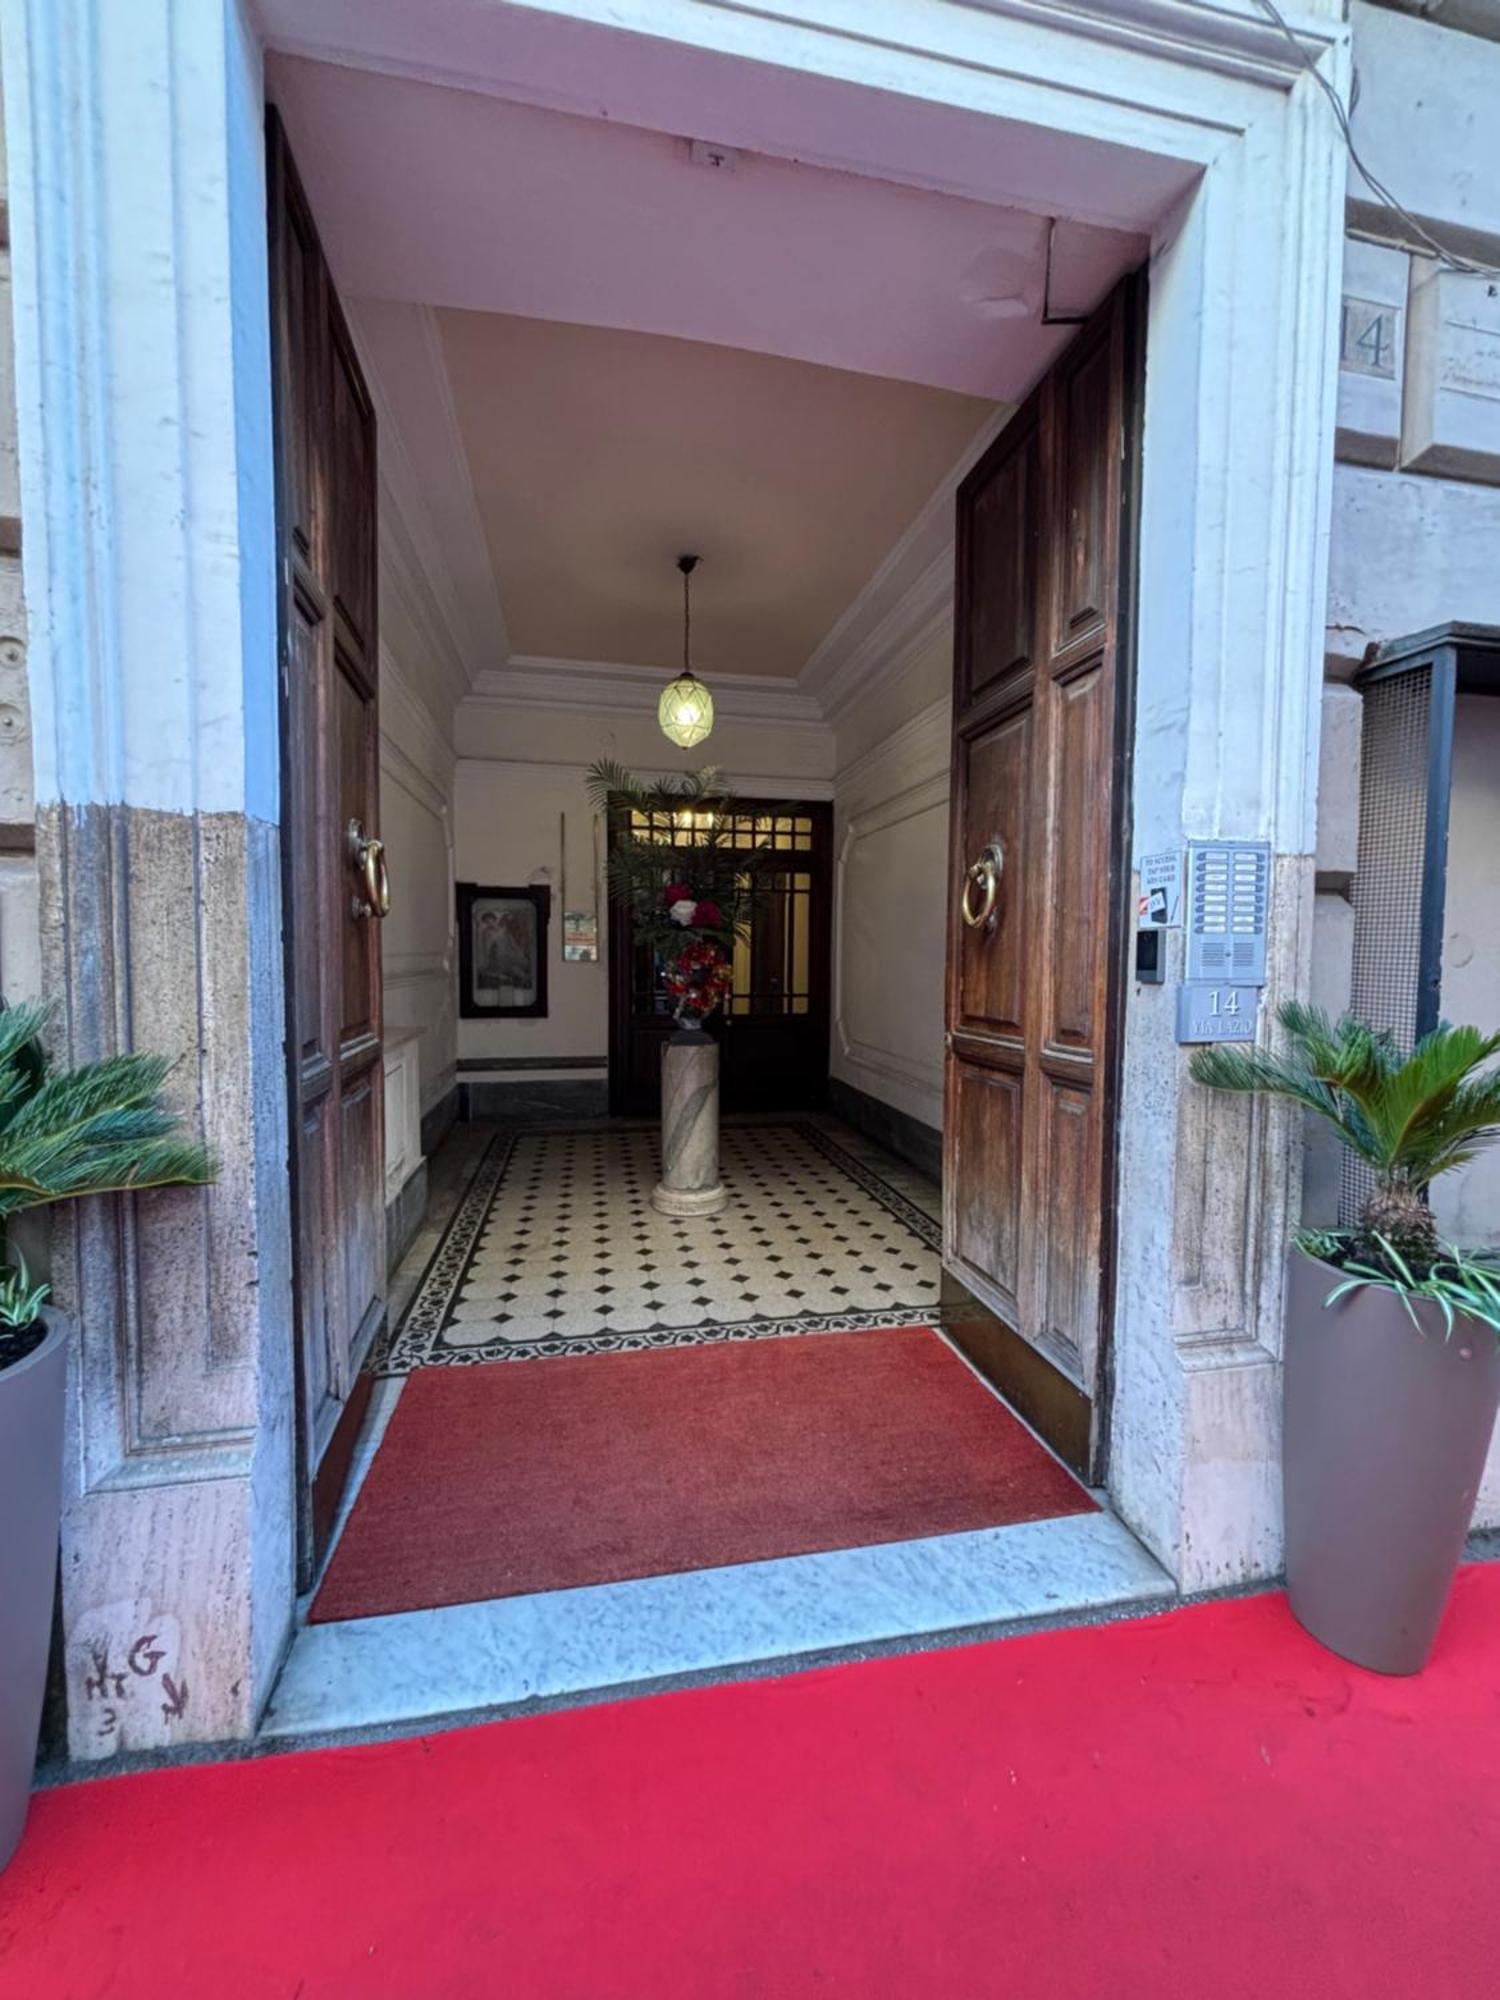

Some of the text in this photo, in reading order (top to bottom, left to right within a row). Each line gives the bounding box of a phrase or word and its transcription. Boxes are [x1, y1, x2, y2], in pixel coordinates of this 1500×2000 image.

[1208, 991, 1240, 1017] 14
[1192, 1019, 1253, 1036] VIA LAZIO
